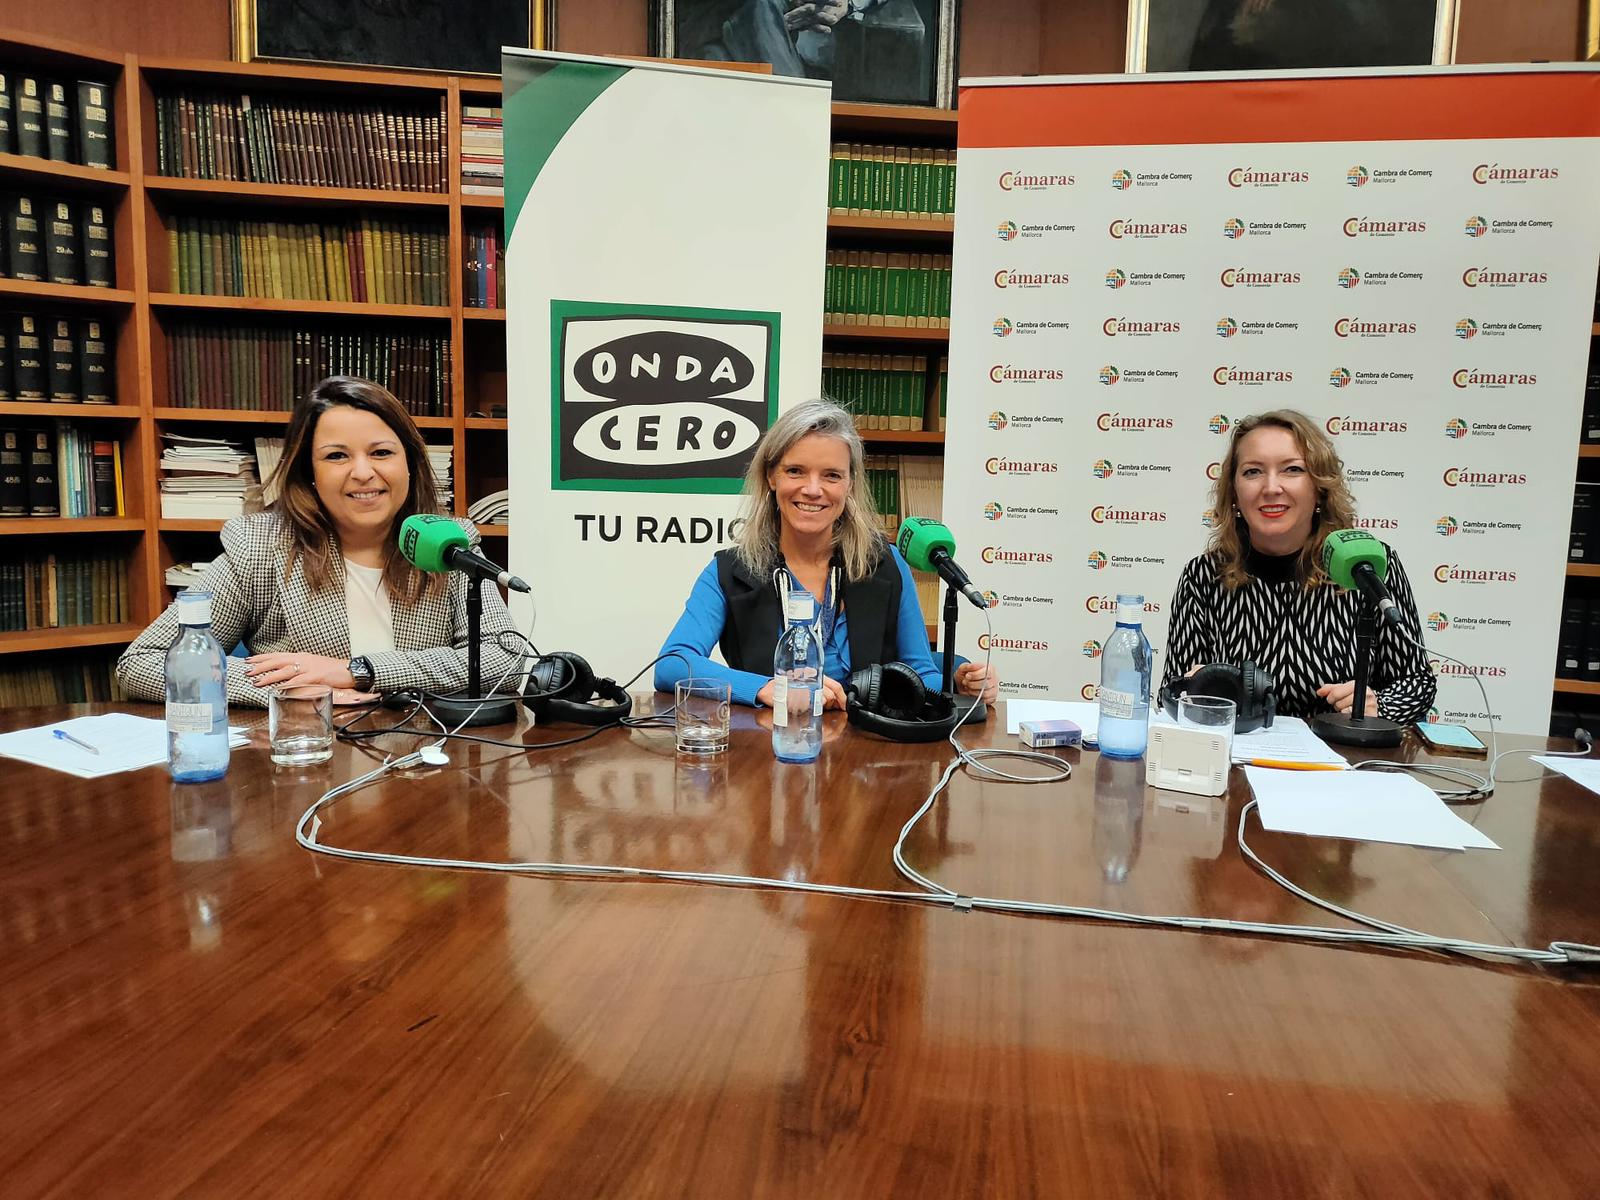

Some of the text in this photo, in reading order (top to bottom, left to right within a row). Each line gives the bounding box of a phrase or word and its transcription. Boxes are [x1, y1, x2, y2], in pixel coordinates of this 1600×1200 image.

[999, 171, 1074, 191] Cámaras
[1228, 167, 1308, 187] Cámaras
[1473, 163, 1558, 184] Cámaras
[1109, 219, 1187, 239] Cámaras
[1343, 217, 1425, 237] Cámaras
[995, 269, 1068, 288] Cámaras
[1221, 268, 1300, 287] Cámaras
[1463, 267, 1547, 287] Cámaras
[1103, 317, 1180, 336] Cámaras
[1335, 318, 1416, 337] Cámaras
[592, 352, 736, 383] ONDA
[990, 365, 1063, 383] Cámaras
[1214, 366, 1292, 385] Cámaras
[1453, 369, 1536, 388] Cámaras
[1097, 413, 1172, 431] Cámaras
[1326, 416, 1407, 435] Cámaras
[600, 415, 736, 450] CERO
[986, 457, 1057, 475] Cámaras
[1443, 467, 1526, 487] Cámaras
[1091, 506, 1166, 524] Cámaras
[574, 515, 622, 542] TU
[982, 547, 1052, 564] Cámaras
[1434, 564, 1516, 584] Cámaras
[1086, 596, 1160, 613] Cámas
[978, 634, 1048, 652] Cámaras
